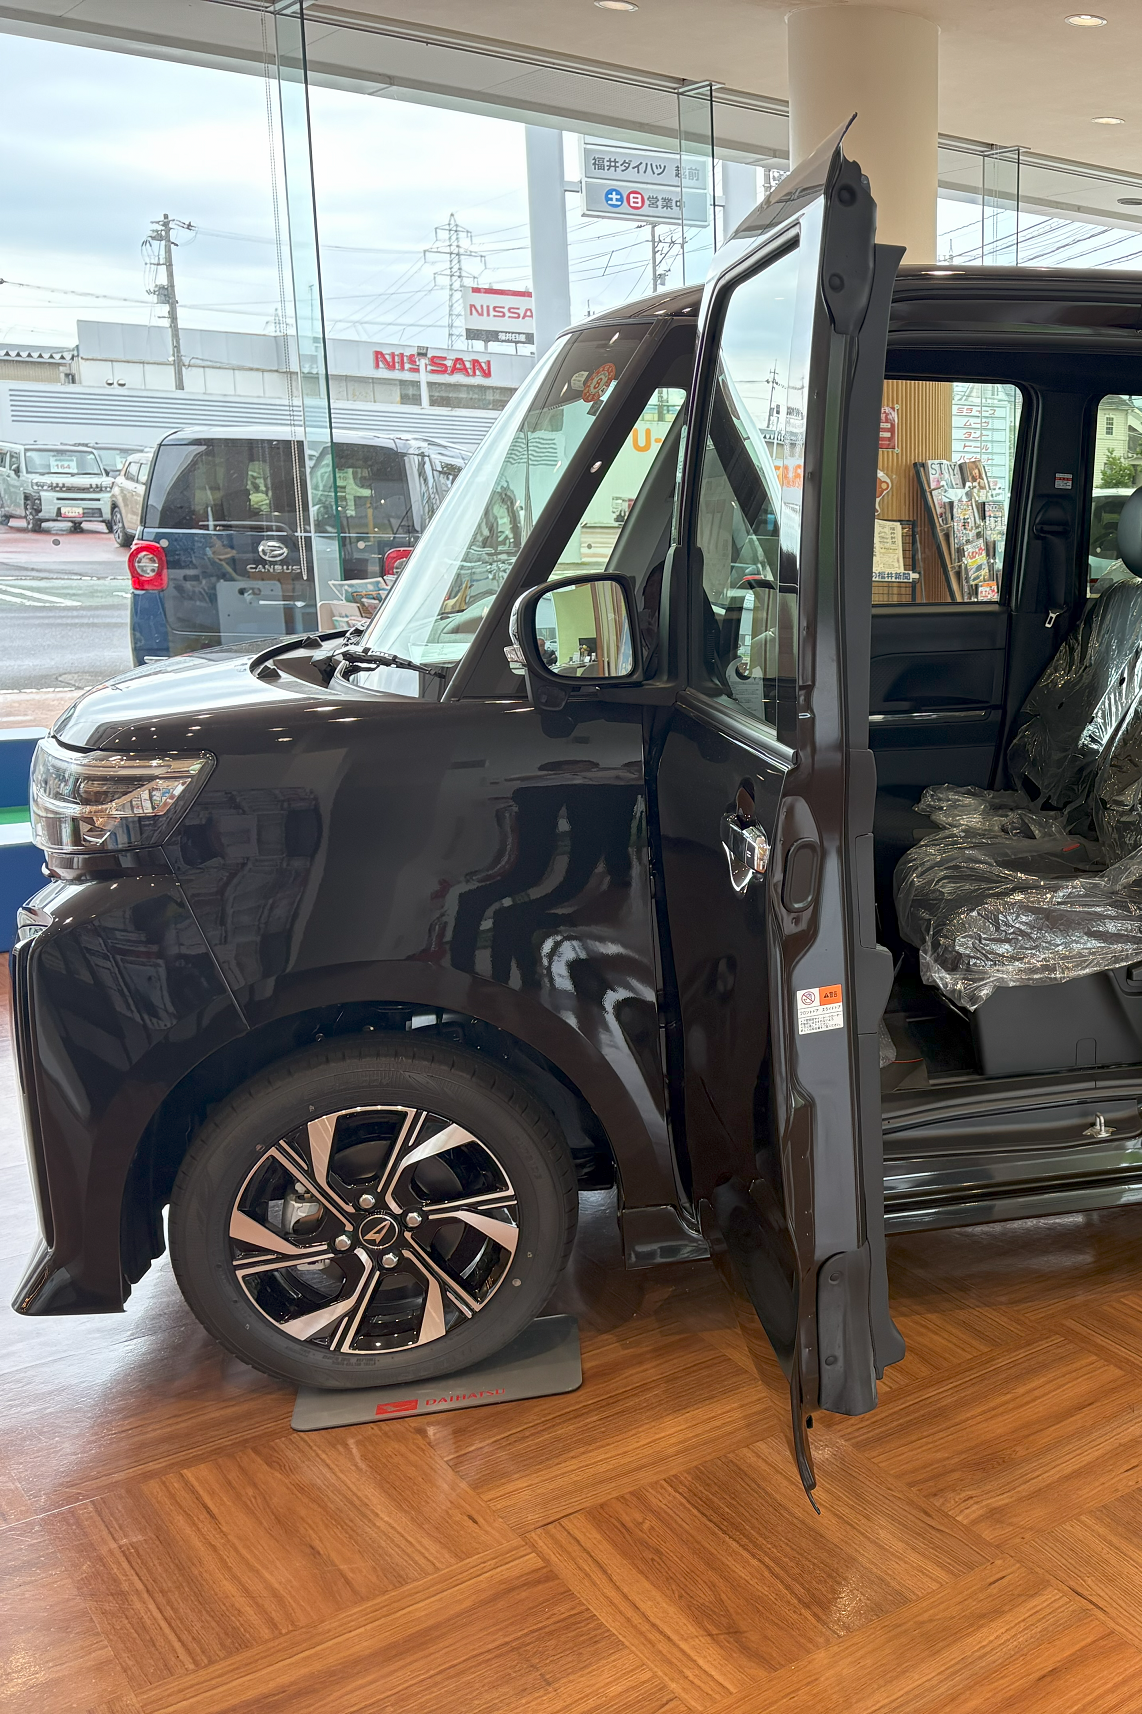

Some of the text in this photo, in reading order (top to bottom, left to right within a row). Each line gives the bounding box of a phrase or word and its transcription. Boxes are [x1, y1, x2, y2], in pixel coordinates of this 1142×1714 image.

[592, 156, 667, 176] 福井ダイハツ
[373, 350, 492, 378] NISSAN
[246, 564, 301, 573] CANBUS
[425, 1388, 505, 1406] DAIHATSU
